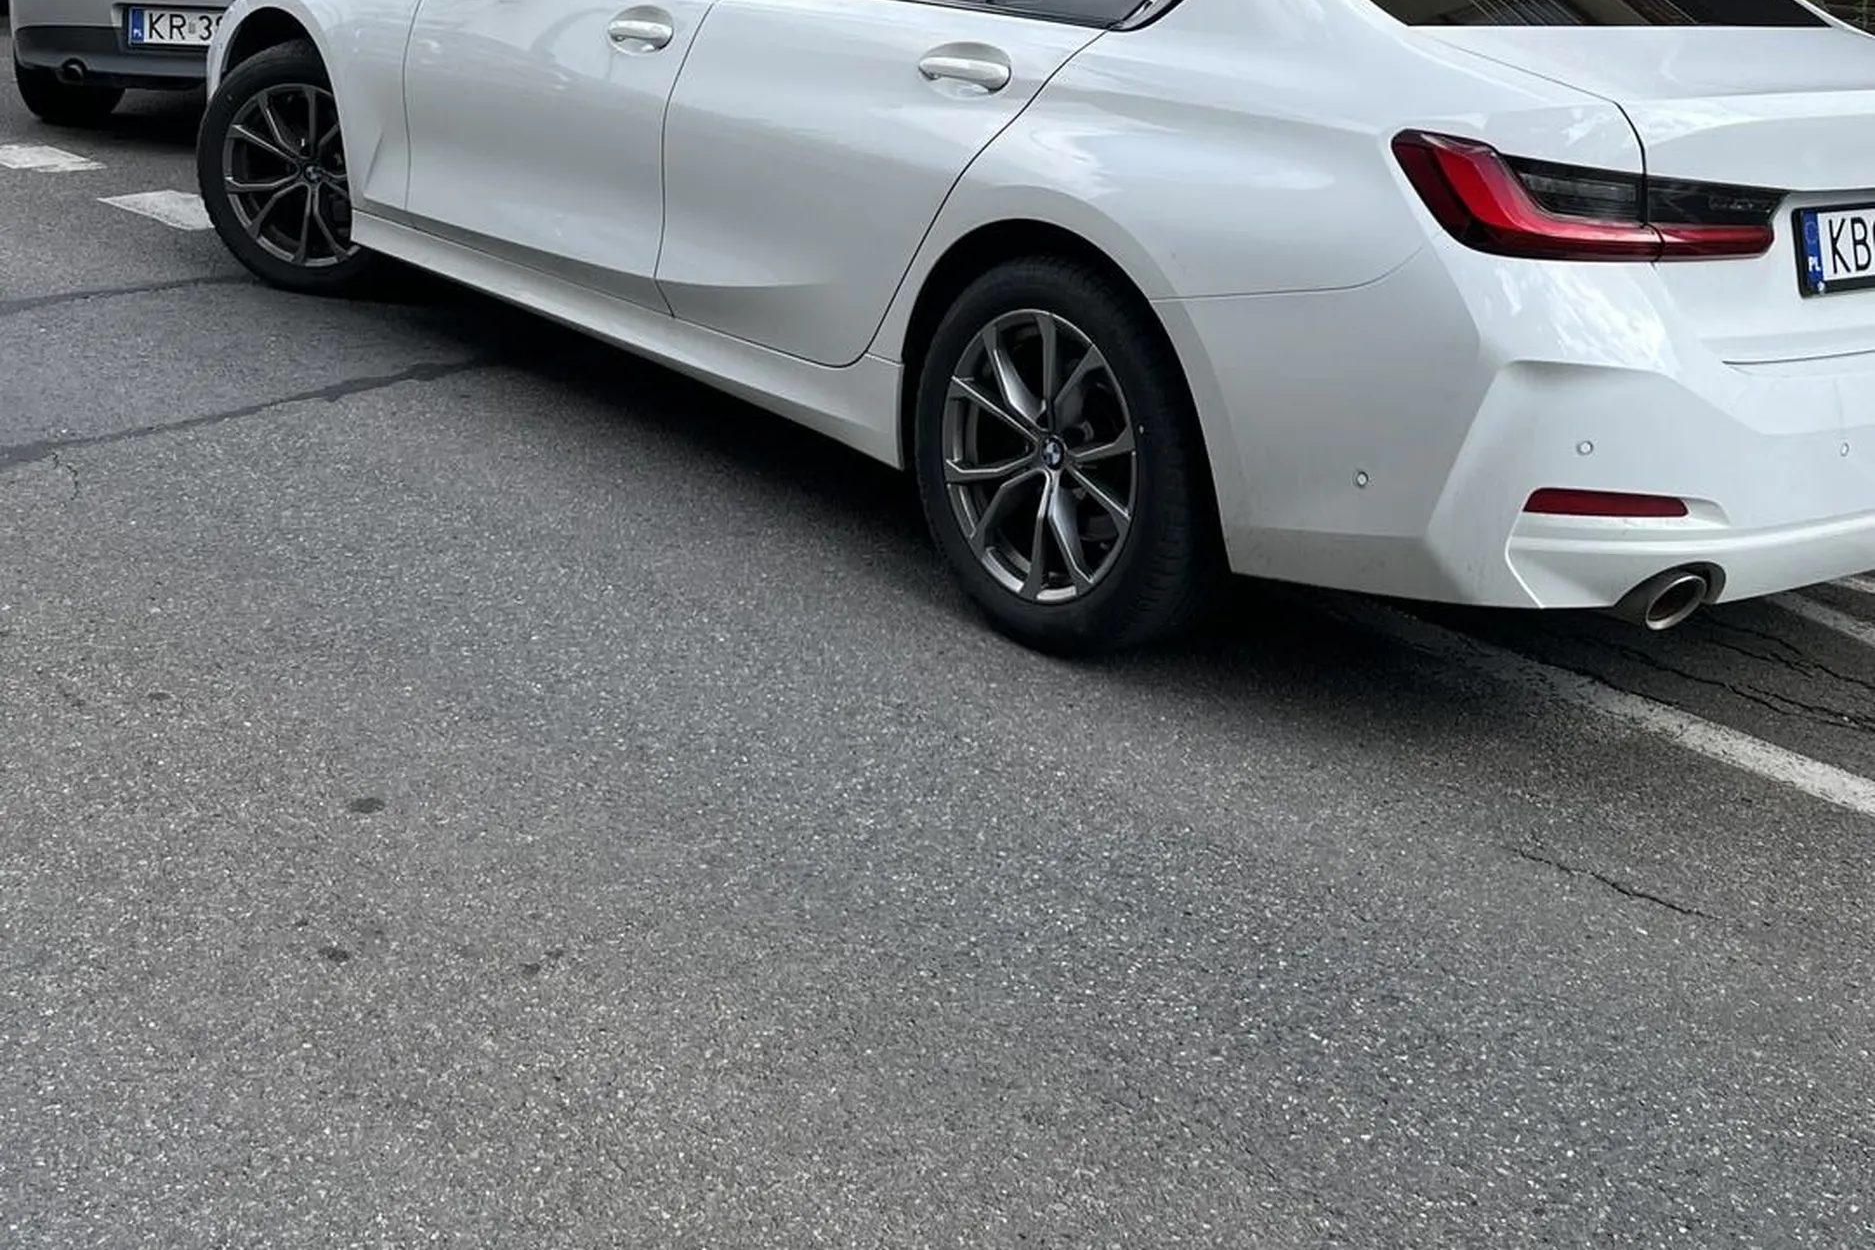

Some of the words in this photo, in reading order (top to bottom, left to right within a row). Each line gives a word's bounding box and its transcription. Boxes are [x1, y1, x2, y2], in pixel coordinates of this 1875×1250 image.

[148, 12, 186, 41] KR
[199, 15, 222, 41] 3
[1828, 216, 1875, 275] KB
